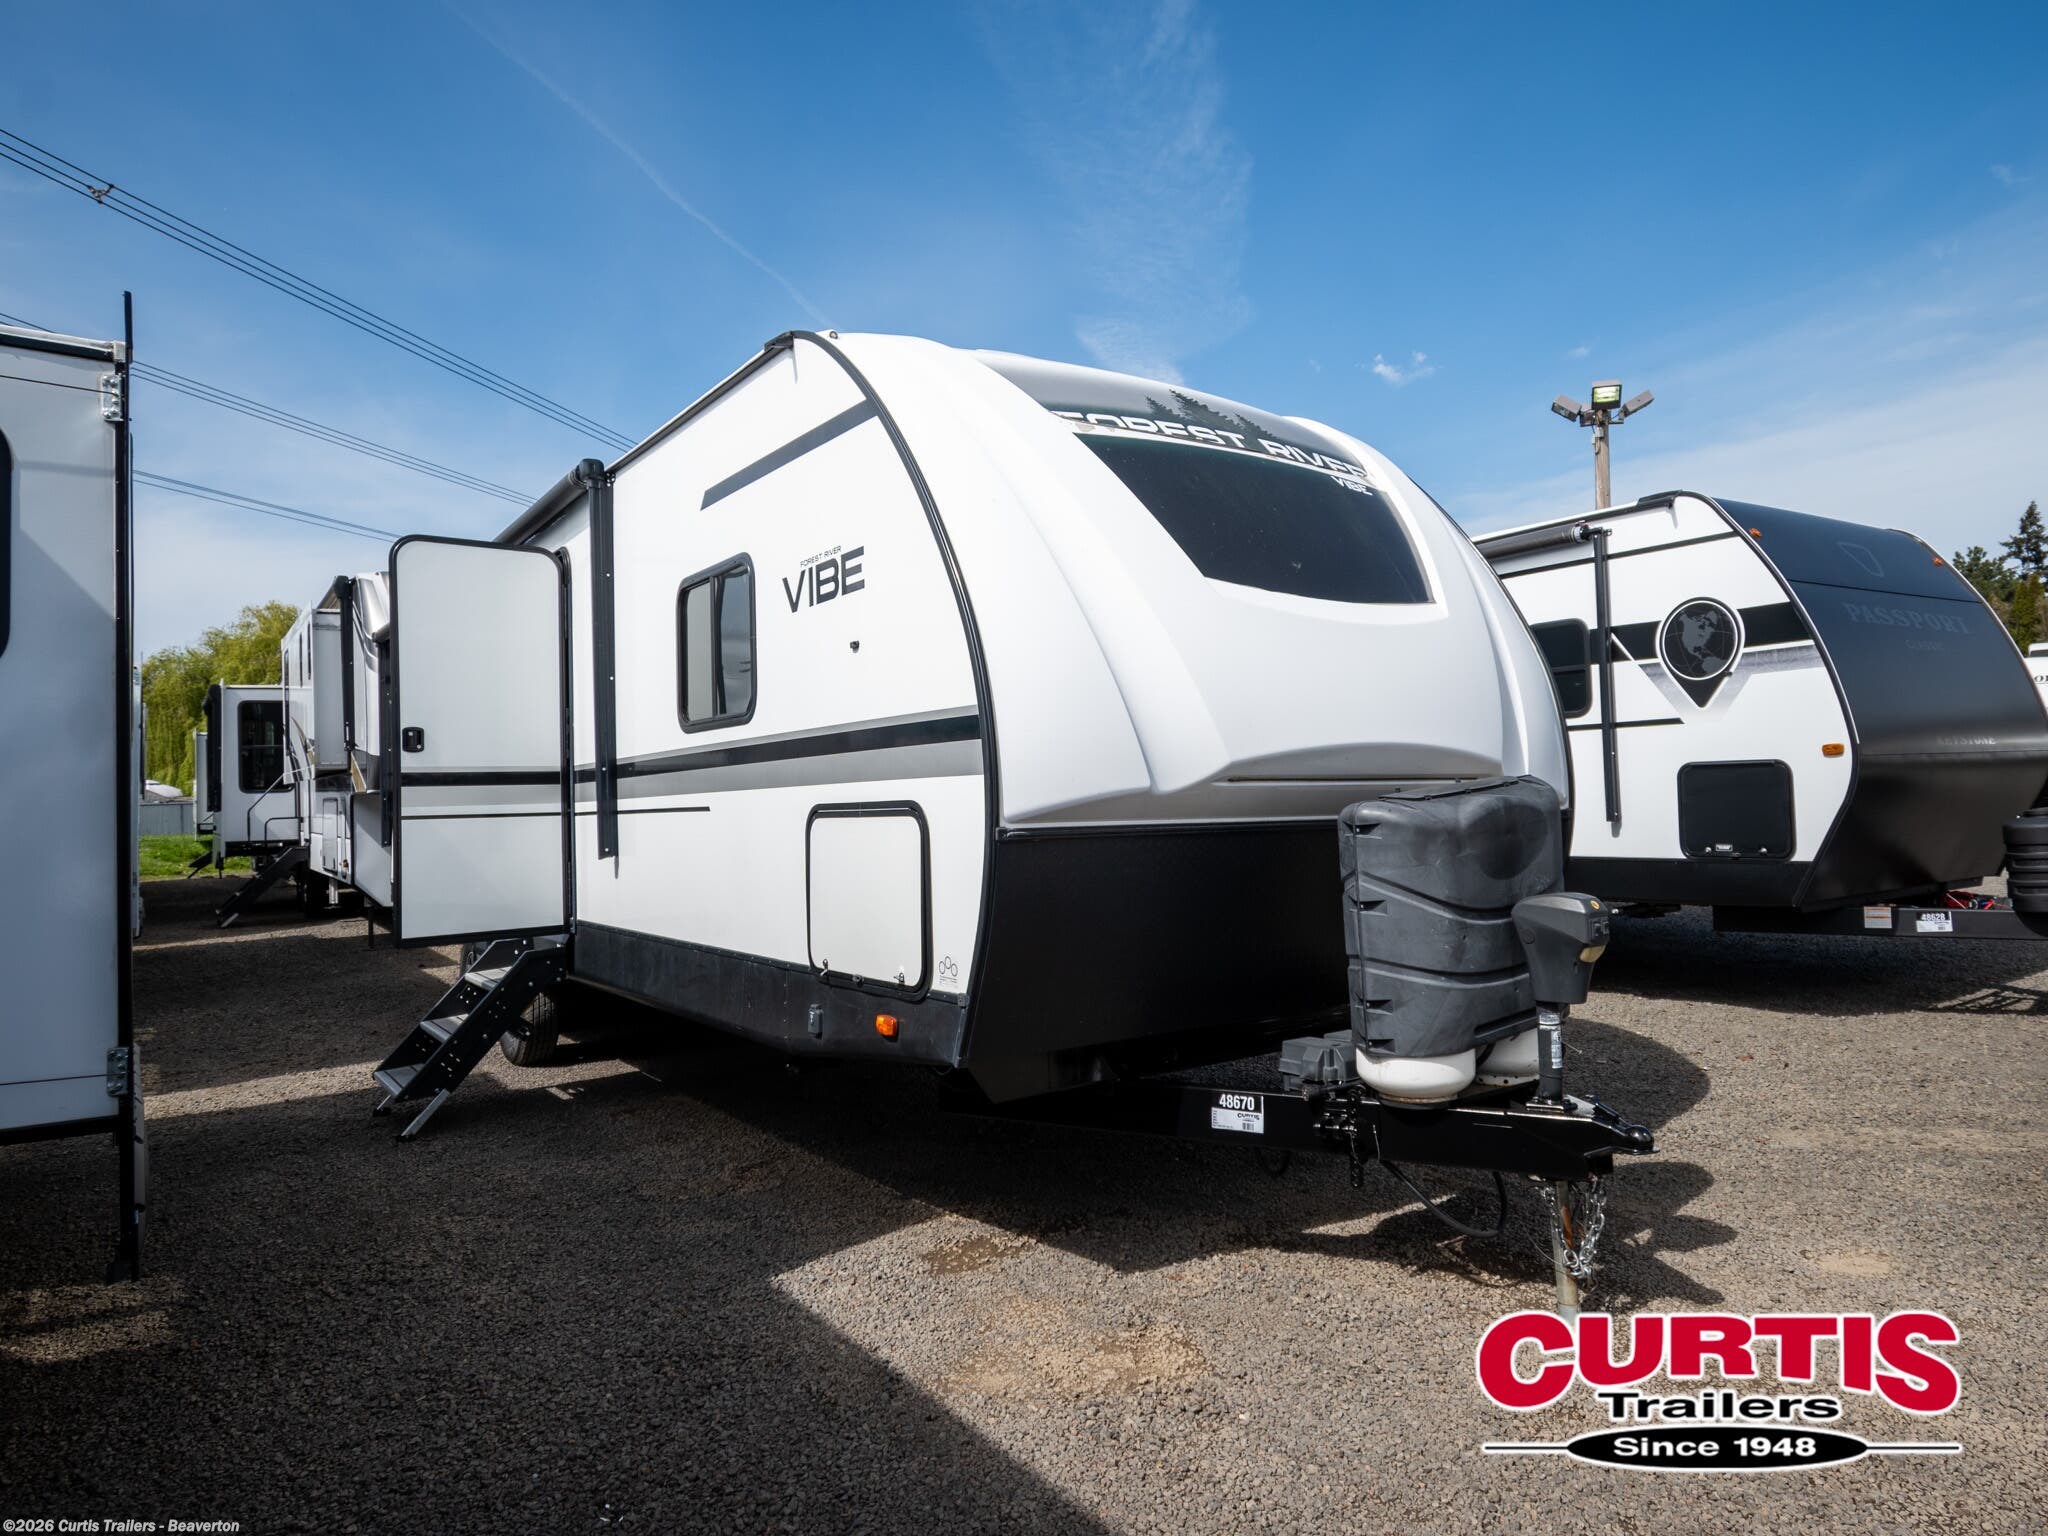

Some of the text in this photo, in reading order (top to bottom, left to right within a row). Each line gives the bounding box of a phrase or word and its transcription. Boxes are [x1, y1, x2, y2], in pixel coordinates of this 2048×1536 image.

[1331, 476, 1373, 496] VIBE
[800, 545, 842, 567] FOREST RIVER
[782, 545, 865, 613] VIBE
[1842, 602, 1970, 634] PASSPORT
[1219, 1094, 1254, 1110] 48670
